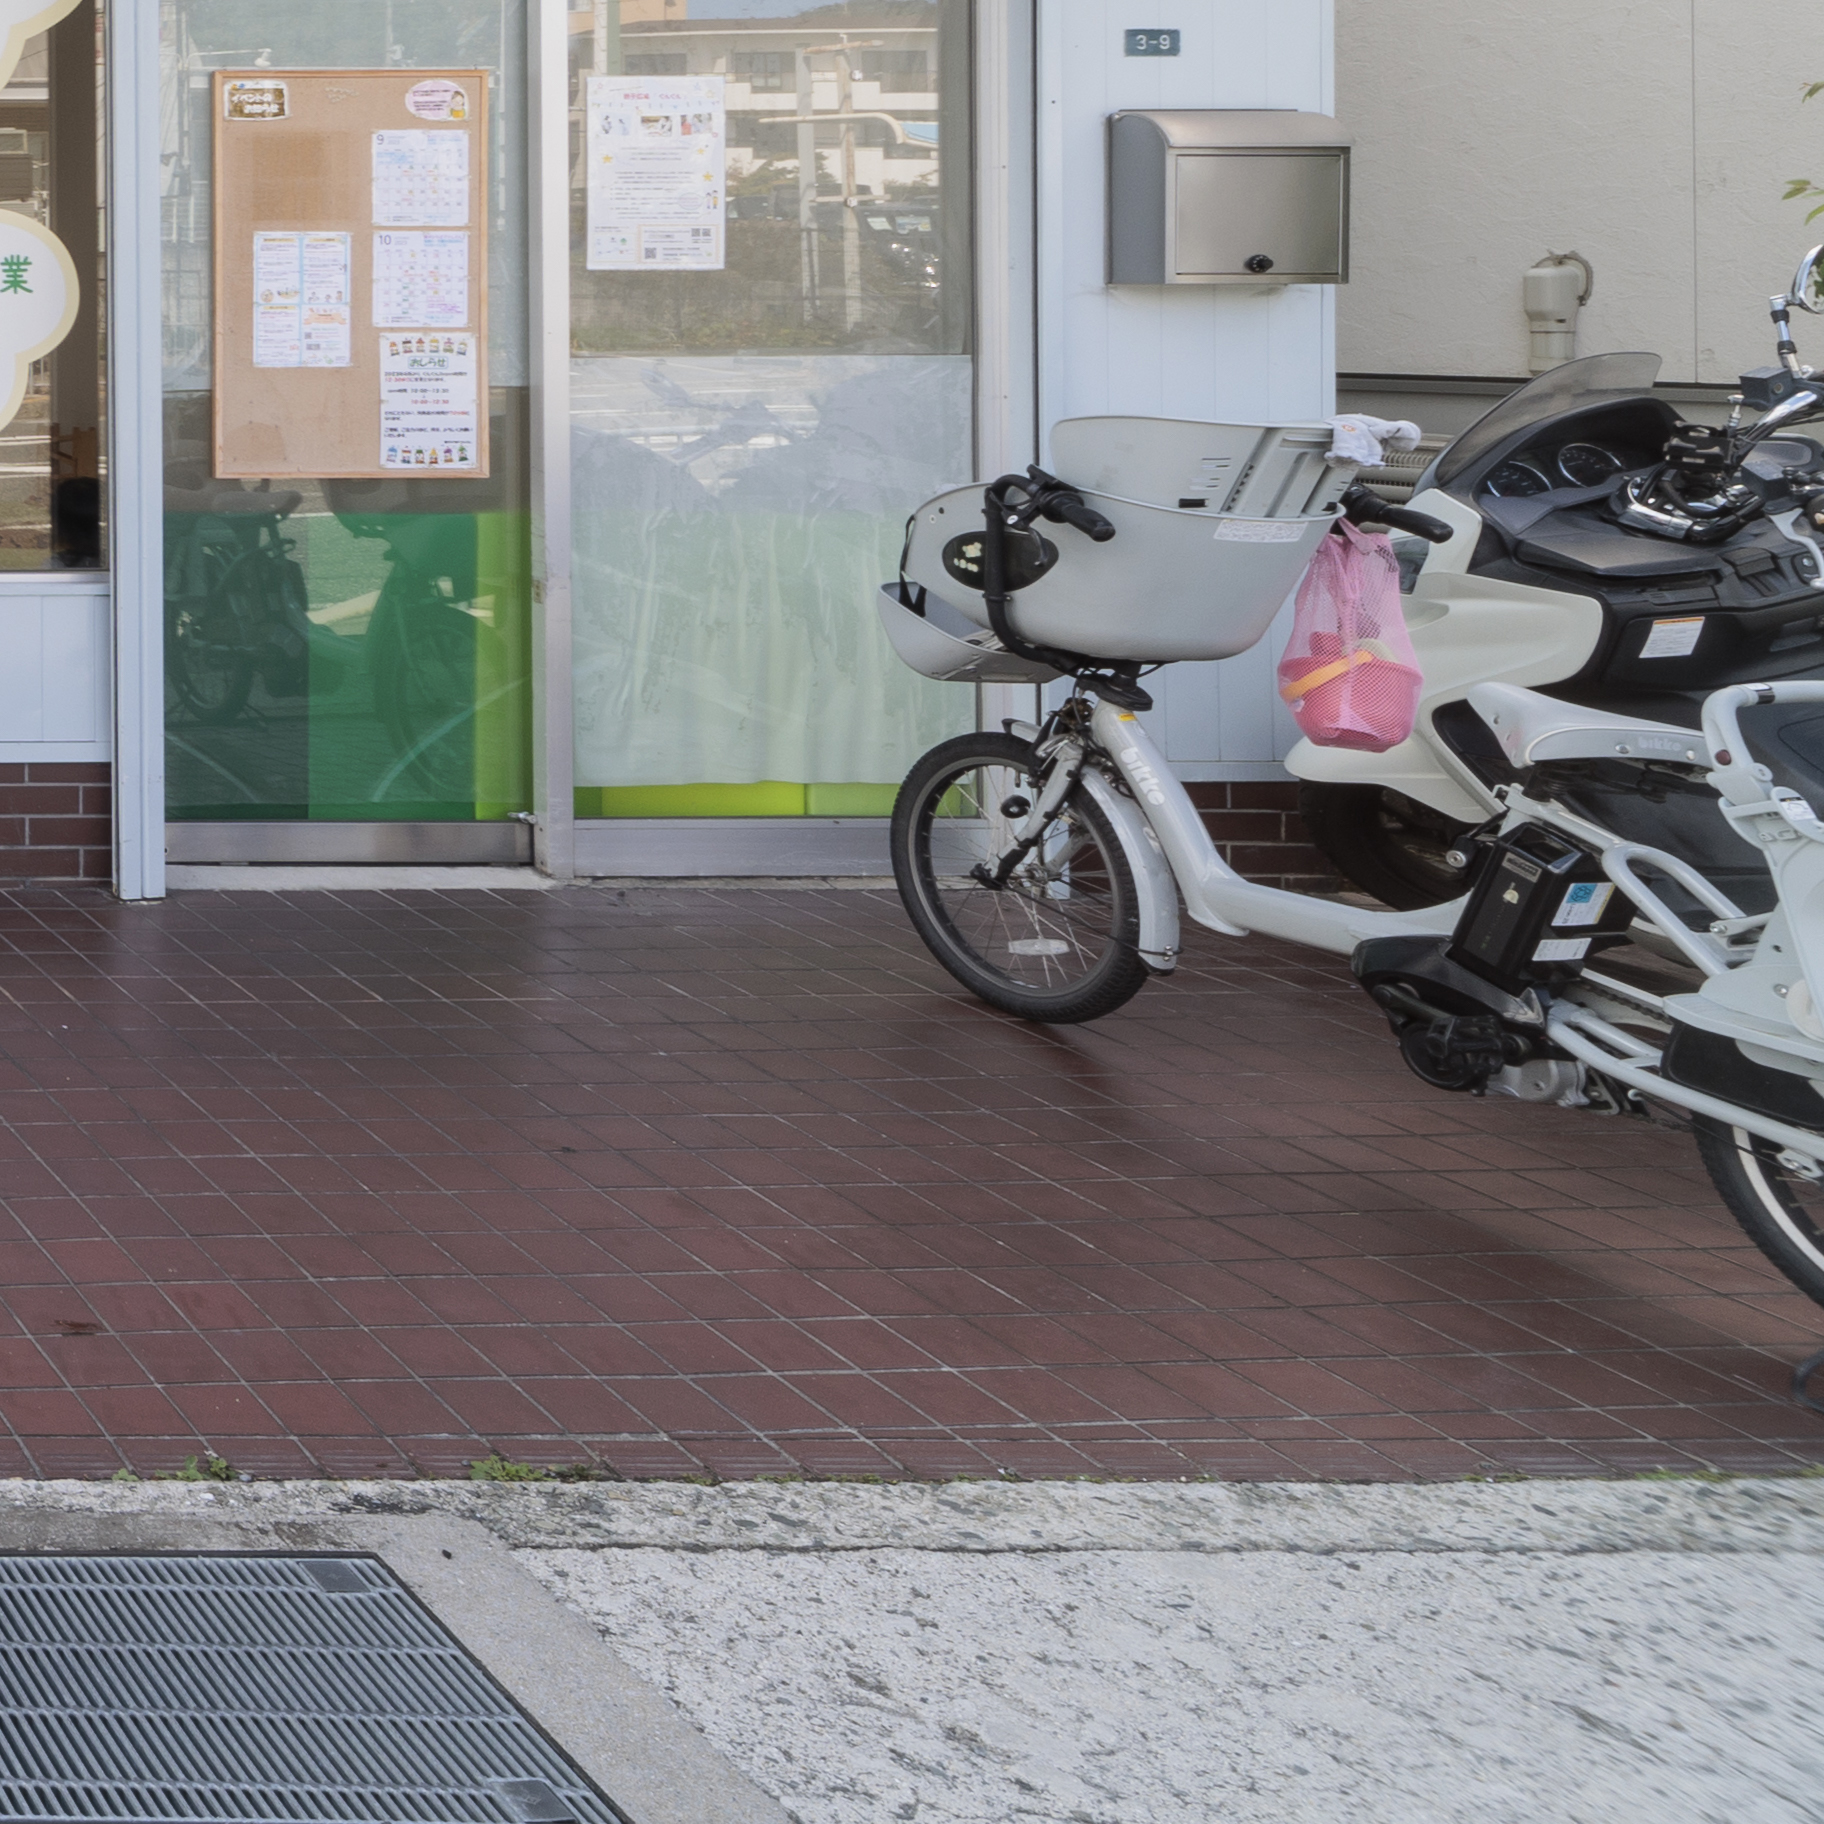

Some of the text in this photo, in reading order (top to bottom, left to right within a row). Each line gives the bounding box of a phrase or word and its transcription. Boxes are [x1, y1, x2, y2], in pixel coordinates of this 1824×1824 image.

[1135, 34, 1171, 50] 3-9
[377, 134, 384, 145] 9
[379, 235, 391, 245] 10
